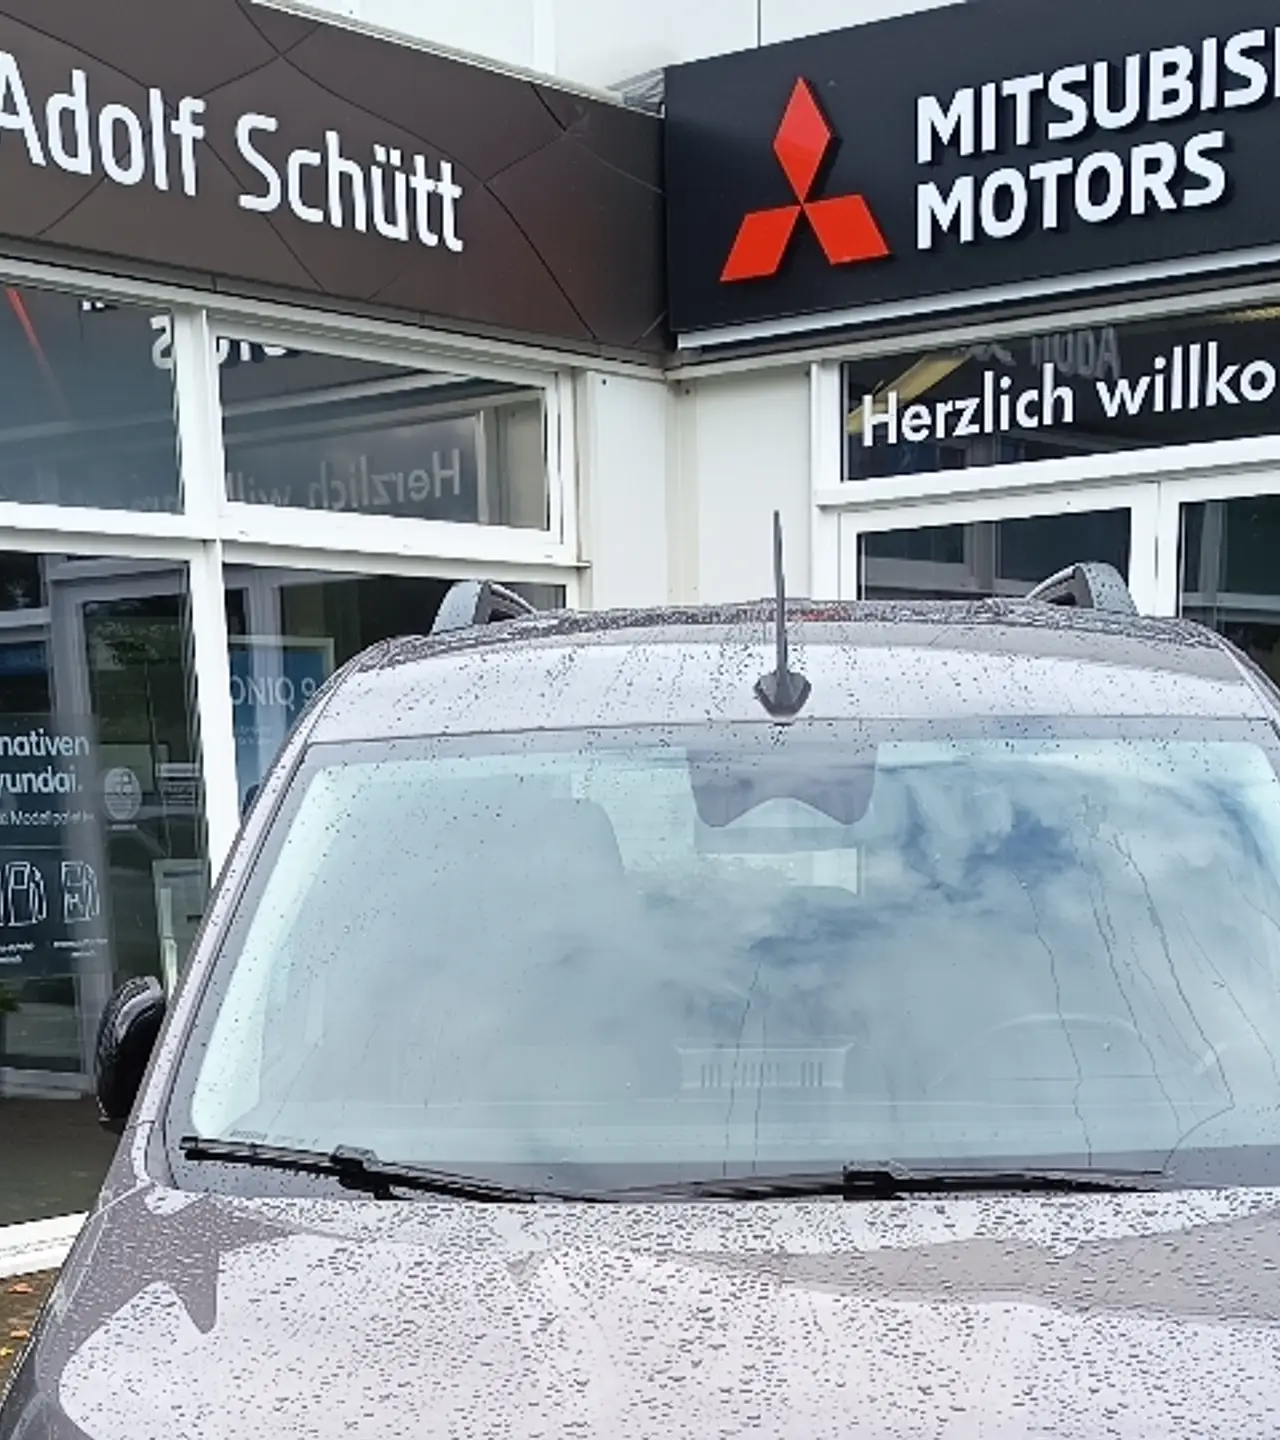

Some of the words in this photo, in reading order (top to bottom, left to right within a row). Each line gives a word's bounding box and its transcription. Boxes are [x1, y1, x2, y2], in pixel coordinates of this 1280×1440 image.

[236, 114, 463, 252] Schütt
[915, 131, 1227, 250] MOTORS
[861, 364, 1073, 447] Herzlich
